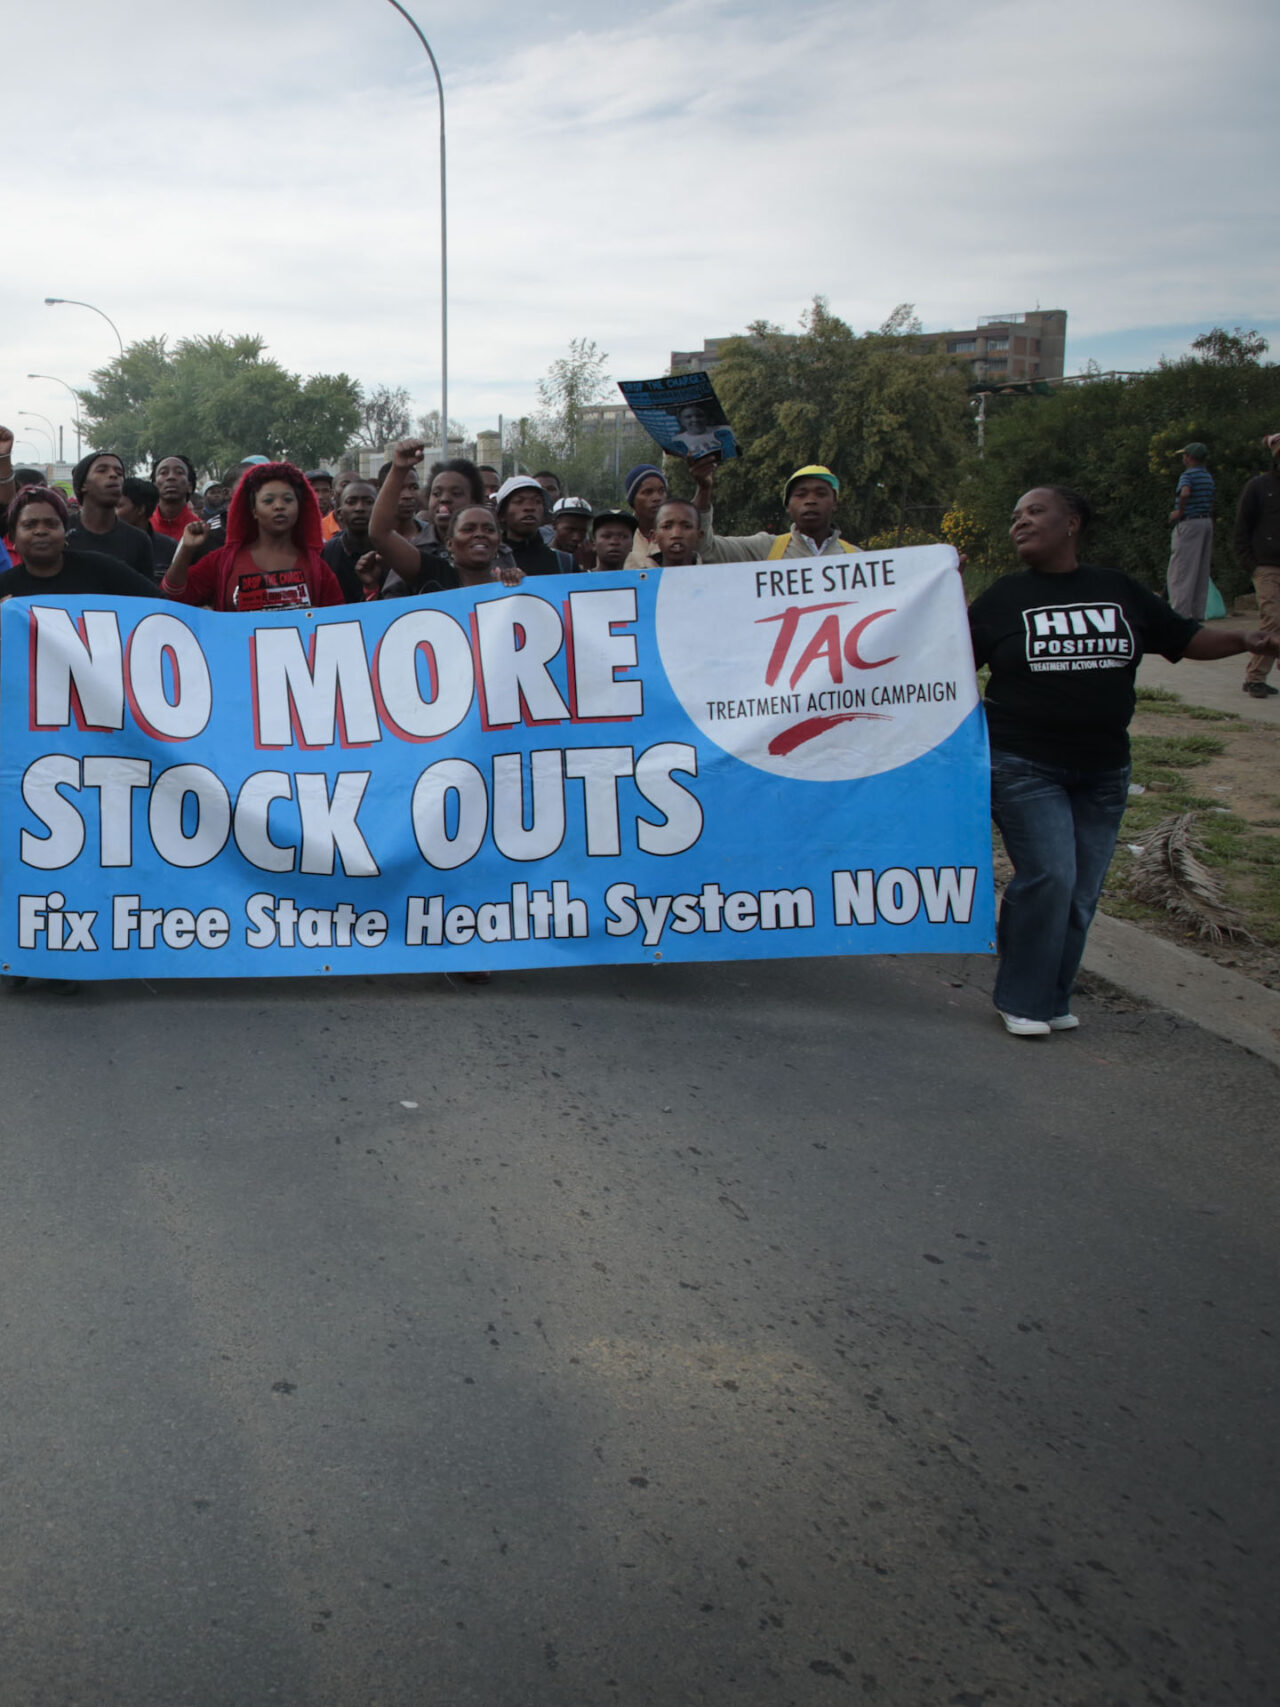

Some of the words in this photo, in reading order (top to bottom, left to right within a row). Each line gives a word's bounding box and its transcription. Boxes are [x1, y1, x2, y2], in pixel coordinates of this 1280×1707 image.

[755, 568, 814, 598] FREE
[822, 559, 896, 592] STATE
[1033, 609, 1116, 636] HIV
[754, 601, 901, 691] TAC
[1033, 639, 1129, 655] POSITIVE
[28, 604, 213, 742] NO
[248, 587, 644, 751] MORE
[1029, 661, 1070, 672] TREATMENT
[1071, 661, 1098, 670] ACTION
[706, 693, 801, 721] TREATMENT
[806, 689, 866, 713] ACTION
[870, 681, 958, 706] CAMPAIGN
[21, 753, 381, 877] STOCK
[411, 741, 704, 870] OUTS
[18, 891, 99, 951] Fix
[113, 893, 231, 950] Free
[245, 892, 388, 949] State
[405, 880, 589, 945] Health
[605, 882, 815, 946] System
[833, 866, 978, 926] NOW
